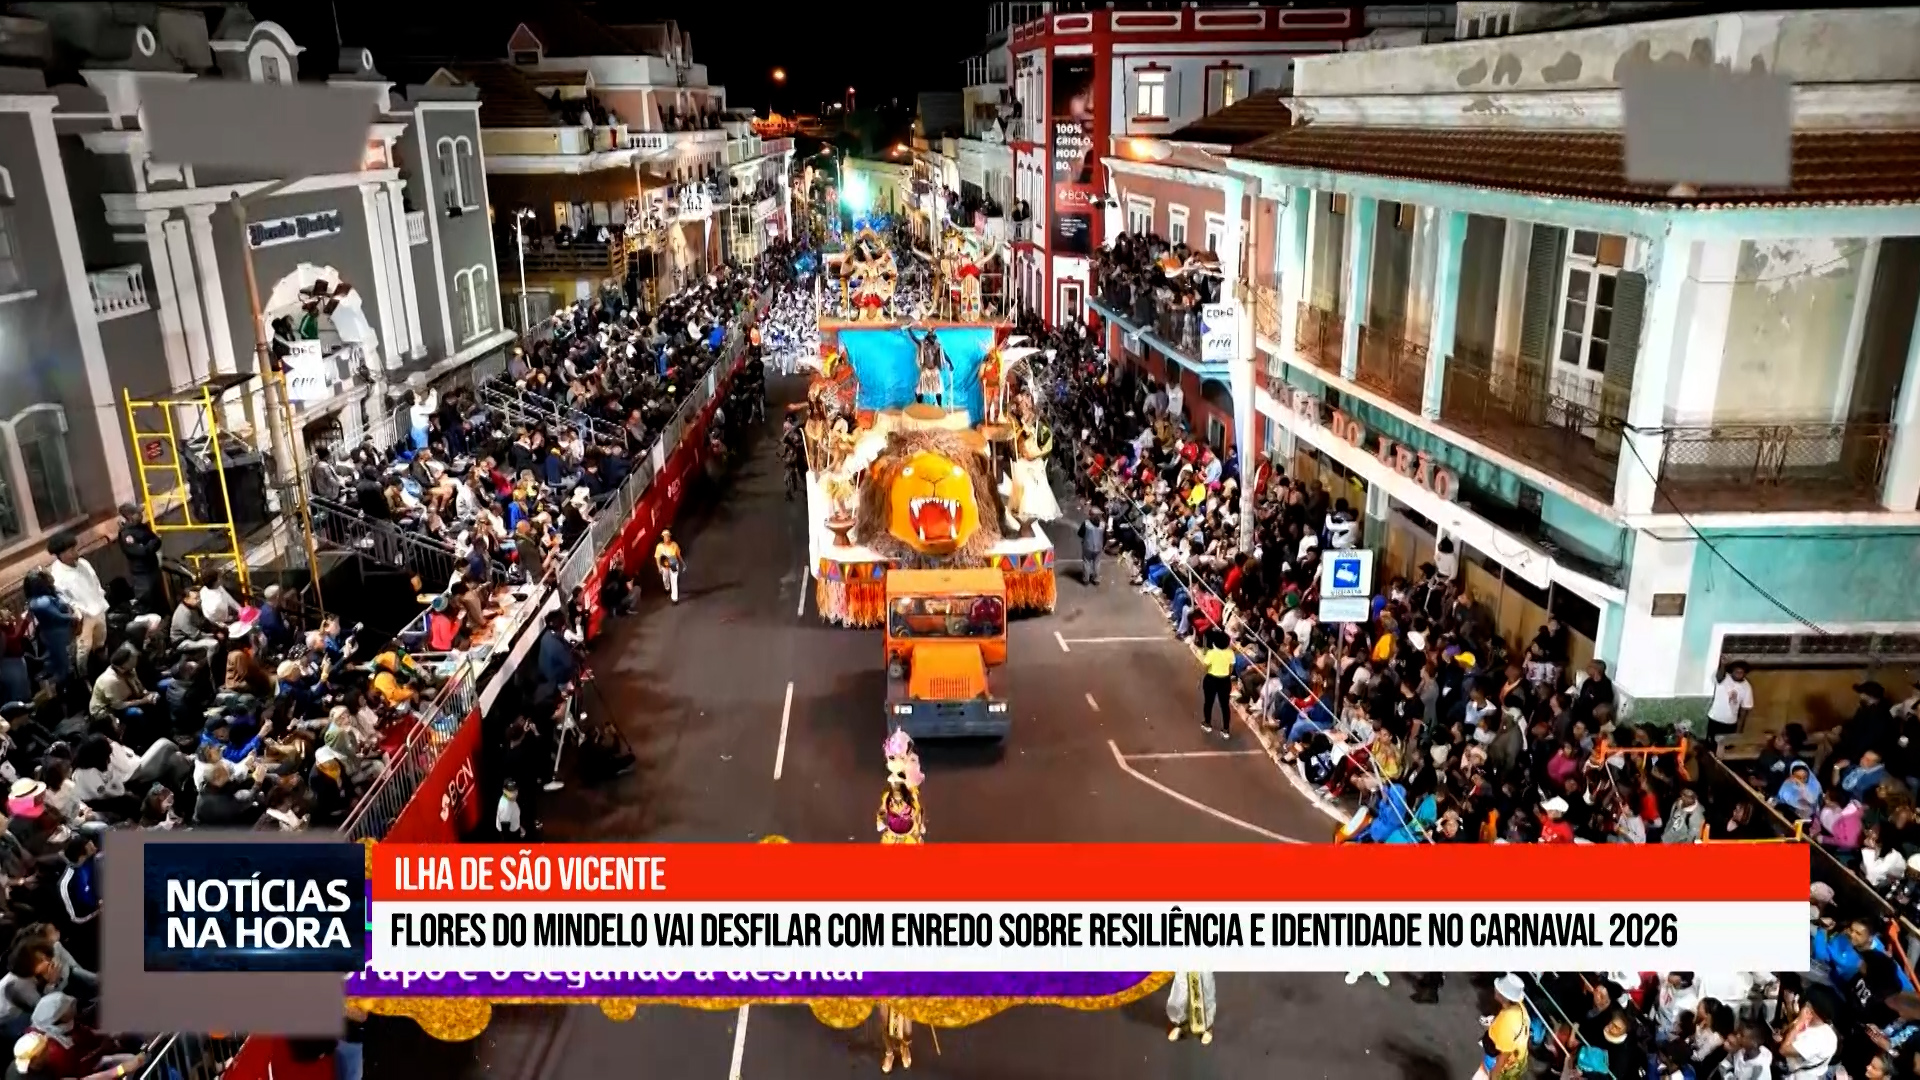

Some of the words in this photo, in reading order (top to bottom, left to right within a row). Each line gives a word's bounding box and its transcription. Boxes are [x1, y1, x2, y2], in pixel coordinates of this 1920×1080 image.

[1055, 123, 1082, 134] 100%
[1332, 409, 1366, 447] DO
[448, 755, 474, 807] BCN
